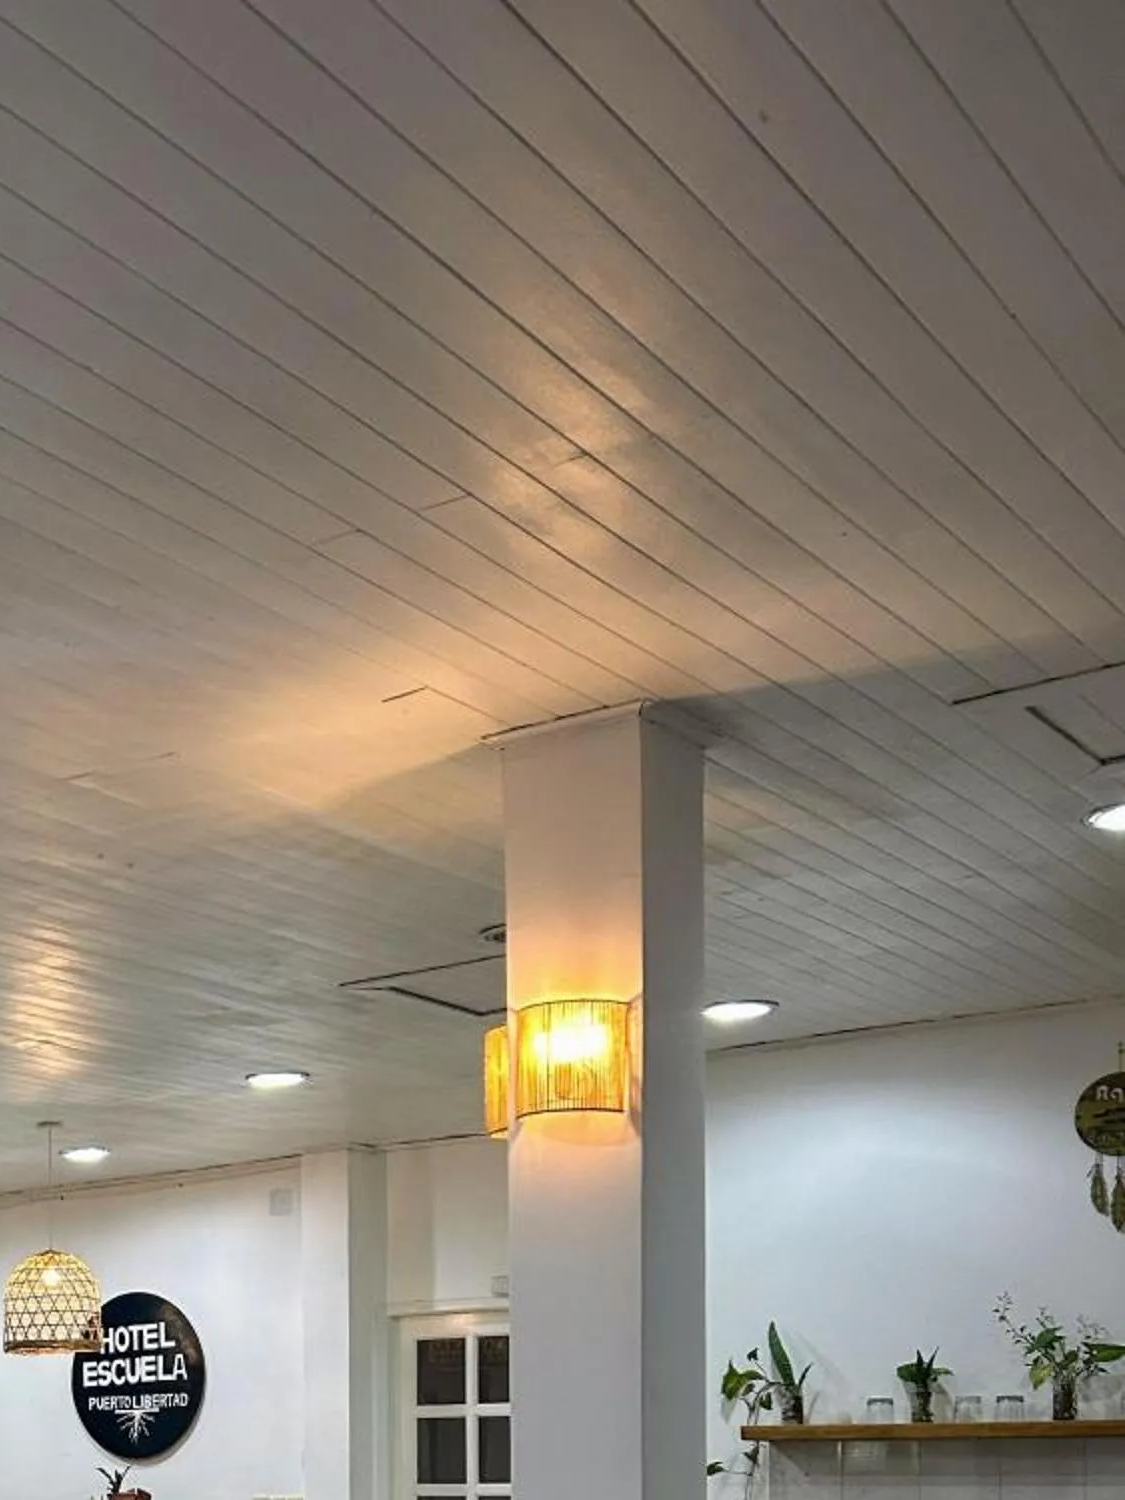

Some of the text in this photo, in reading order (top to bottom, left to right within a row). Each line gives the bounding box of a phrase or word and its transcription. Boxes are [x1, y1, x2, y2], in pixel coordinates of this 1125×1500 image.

[99, 1321, 176, 1355] HOTEL
[82, 1353, 188, 1388] ESCUELA
[88, 1393, 189, 1411] PUERTO LIBERTAD
